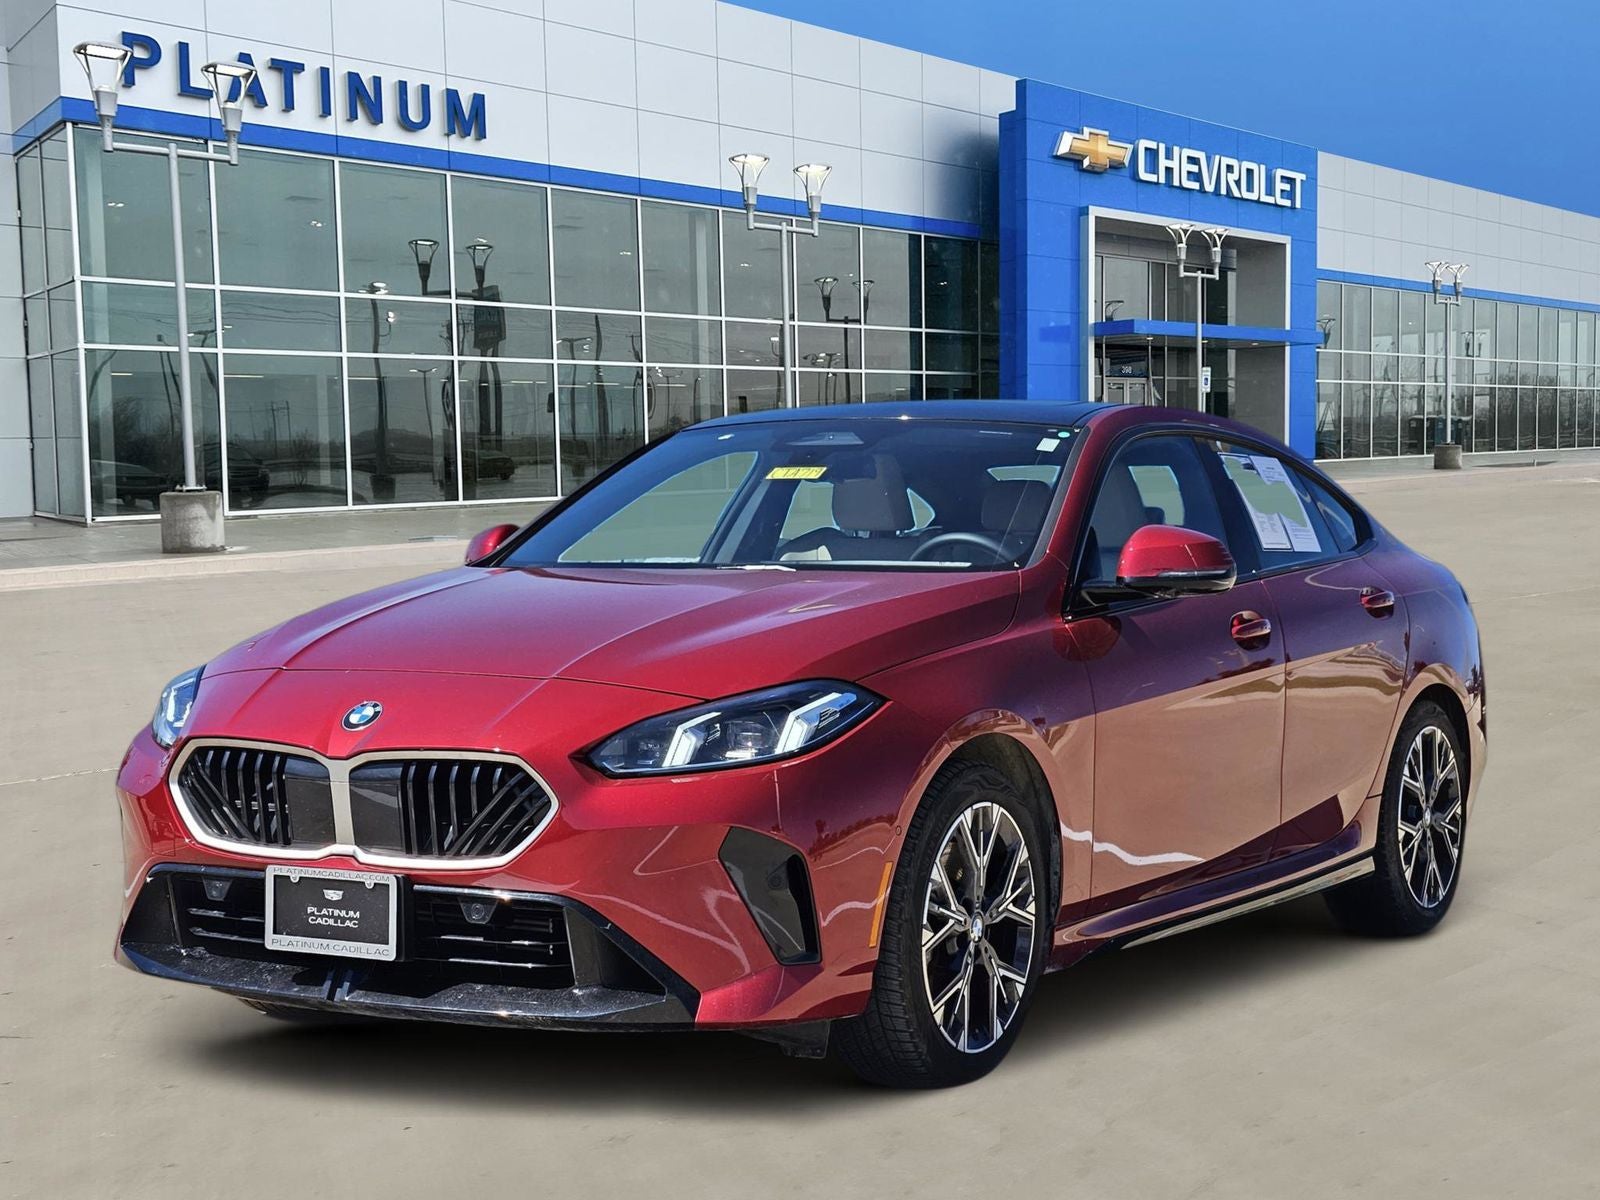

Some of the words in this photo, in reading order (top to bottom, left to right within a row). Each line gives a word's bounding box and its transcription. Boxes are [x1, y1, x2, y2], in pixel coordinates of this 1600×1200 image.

[121, 31, 487, 141] PLATINUM
[1136, 138, 1306, 209] CHEVROLET
[307, 906, 360, 919] PLATINUM
[308, 917, 358, 928] CADILLAC
[271, 938, 330, 951] PLATINUM
[332, 944, 389, 957] CADILLAC
